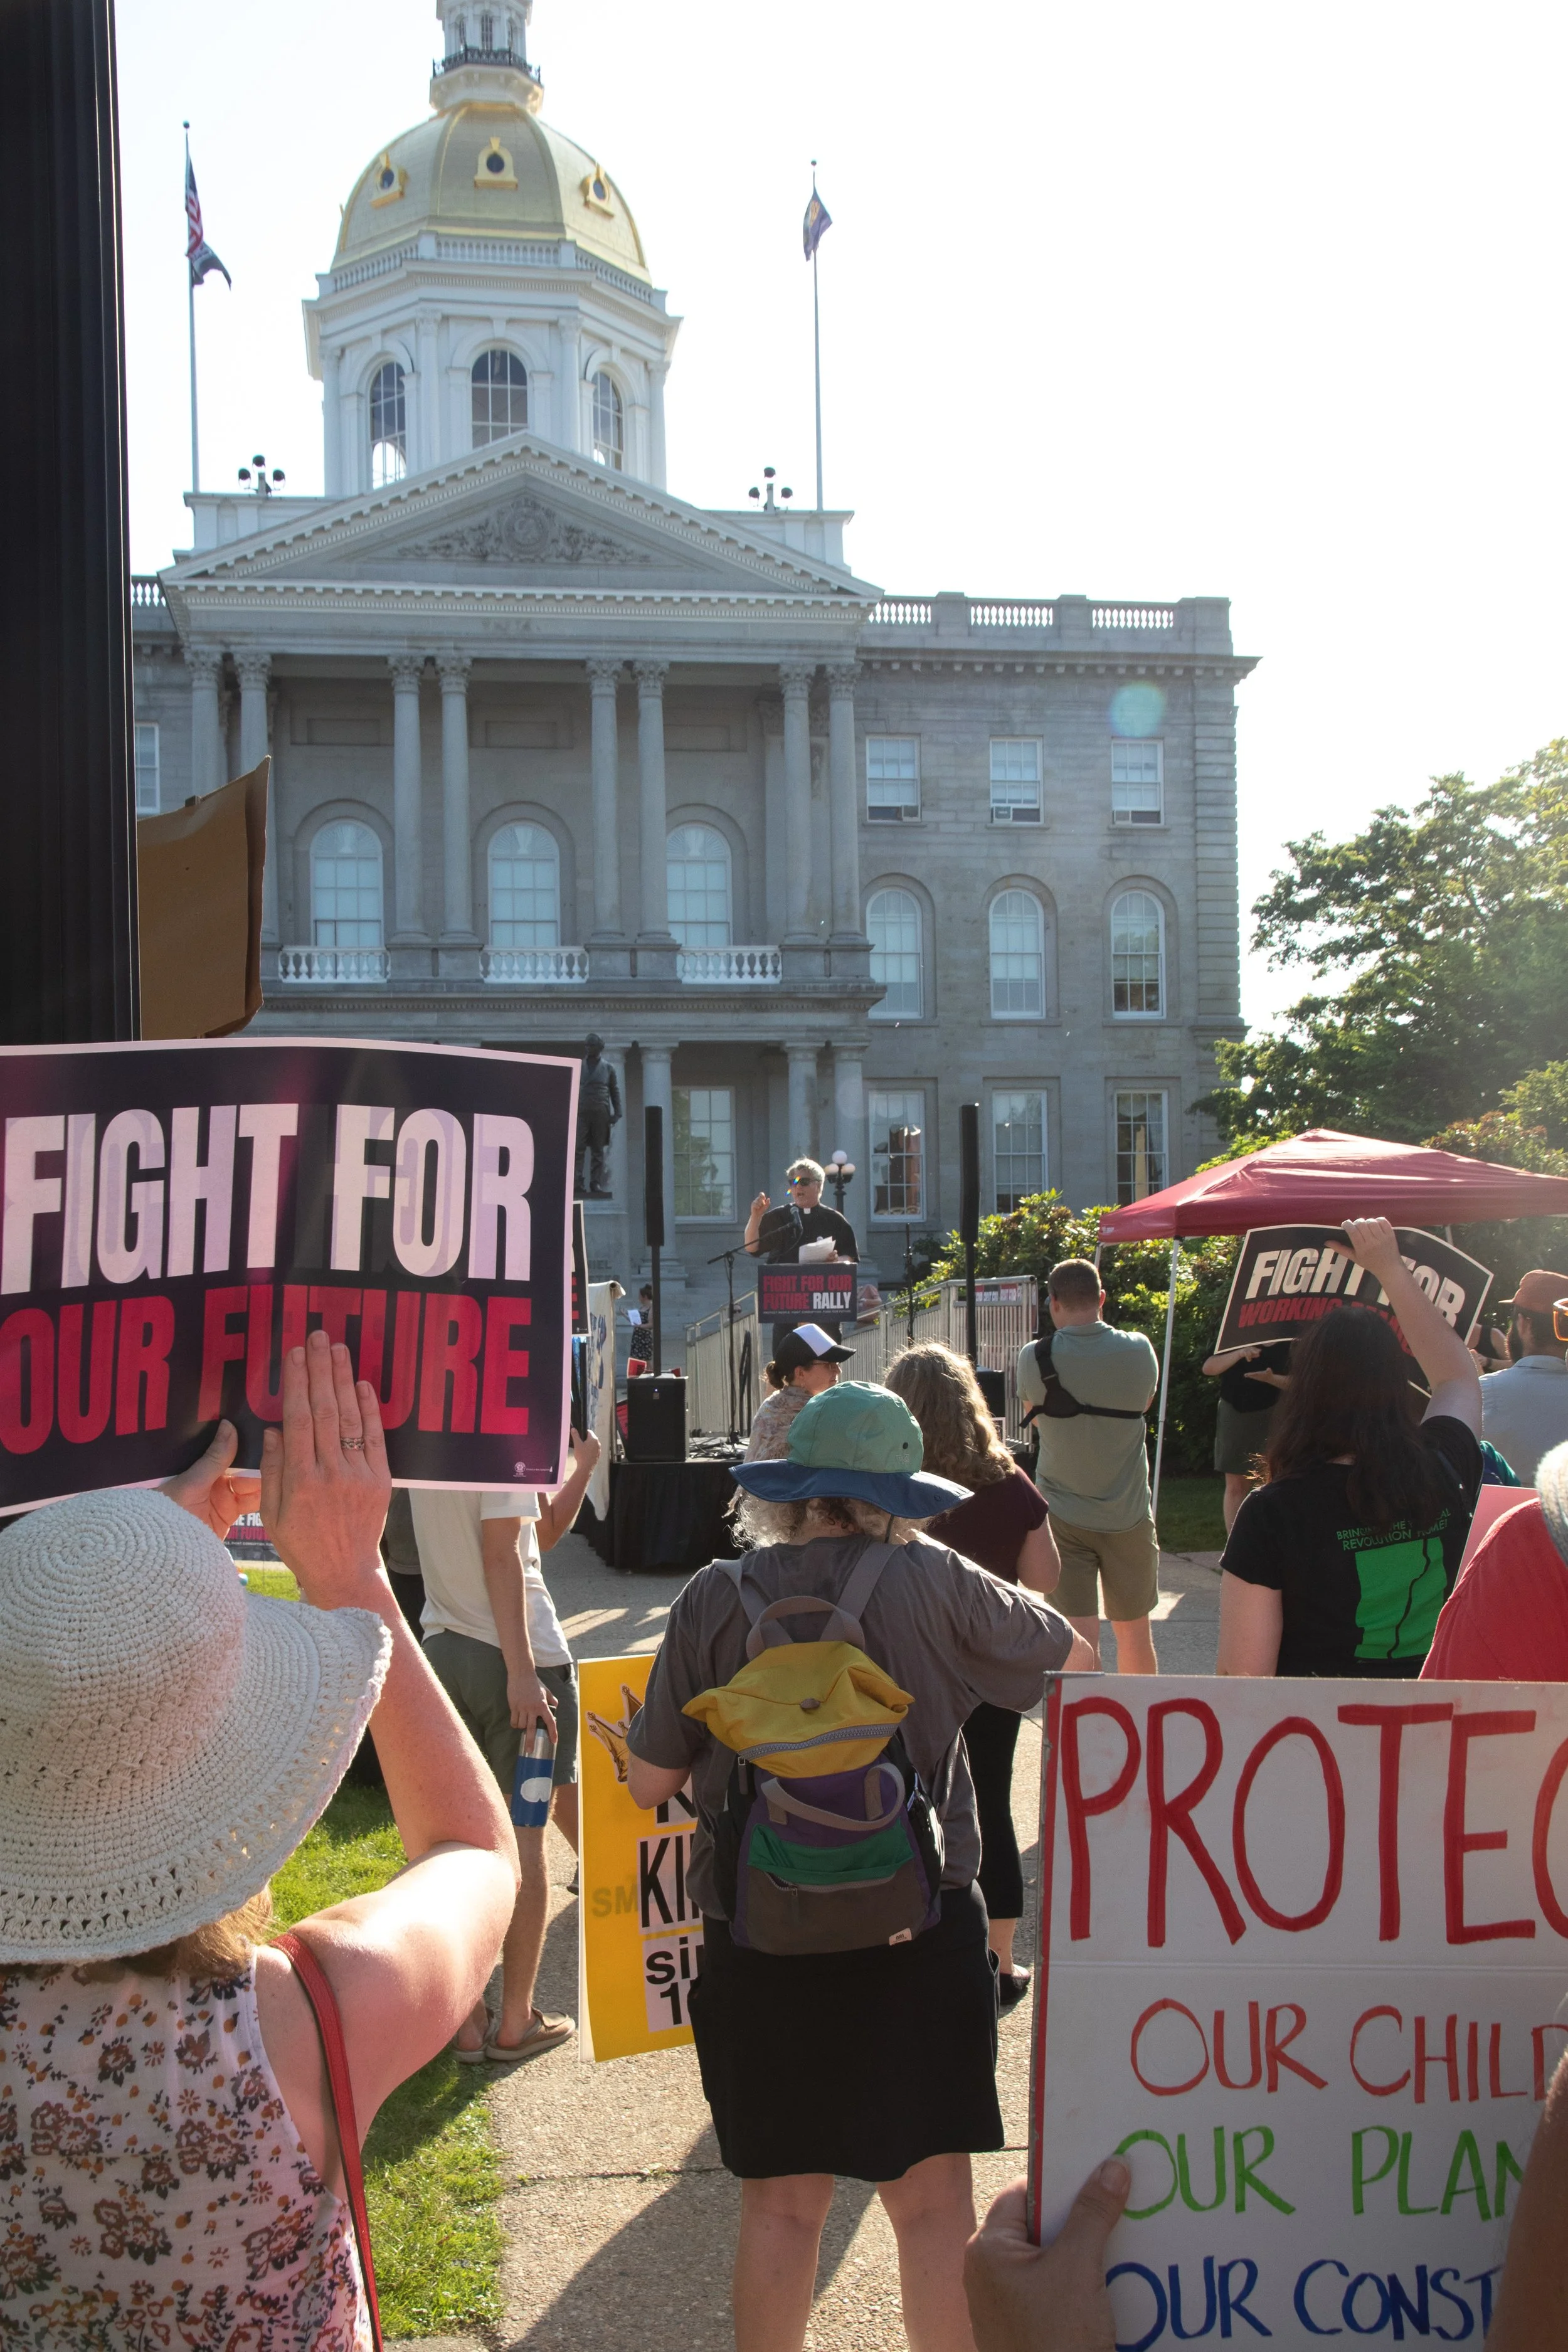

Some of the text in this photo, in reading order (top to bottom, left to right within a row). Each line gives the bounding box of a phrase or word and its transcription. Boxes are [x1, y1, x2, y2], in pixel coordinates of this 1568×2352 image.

[0, 1103, 534, 1295] FIGHT FOR
[763, 1274, 852, 1292] FIGHT FOR OUR
[763, 1292, 852, 1310] FUTURE RALLY
[0, 1295, 175, 1454] OUR
[198, 1284, 532, 1435] FUTURE
[640, 1833, 700, 1929] KI
[1130, 1998, 1328, 2096] OUR
[1112, 2125, 1296, 2220] OUR
[1106, 2255, 1273, 2352] OUR
